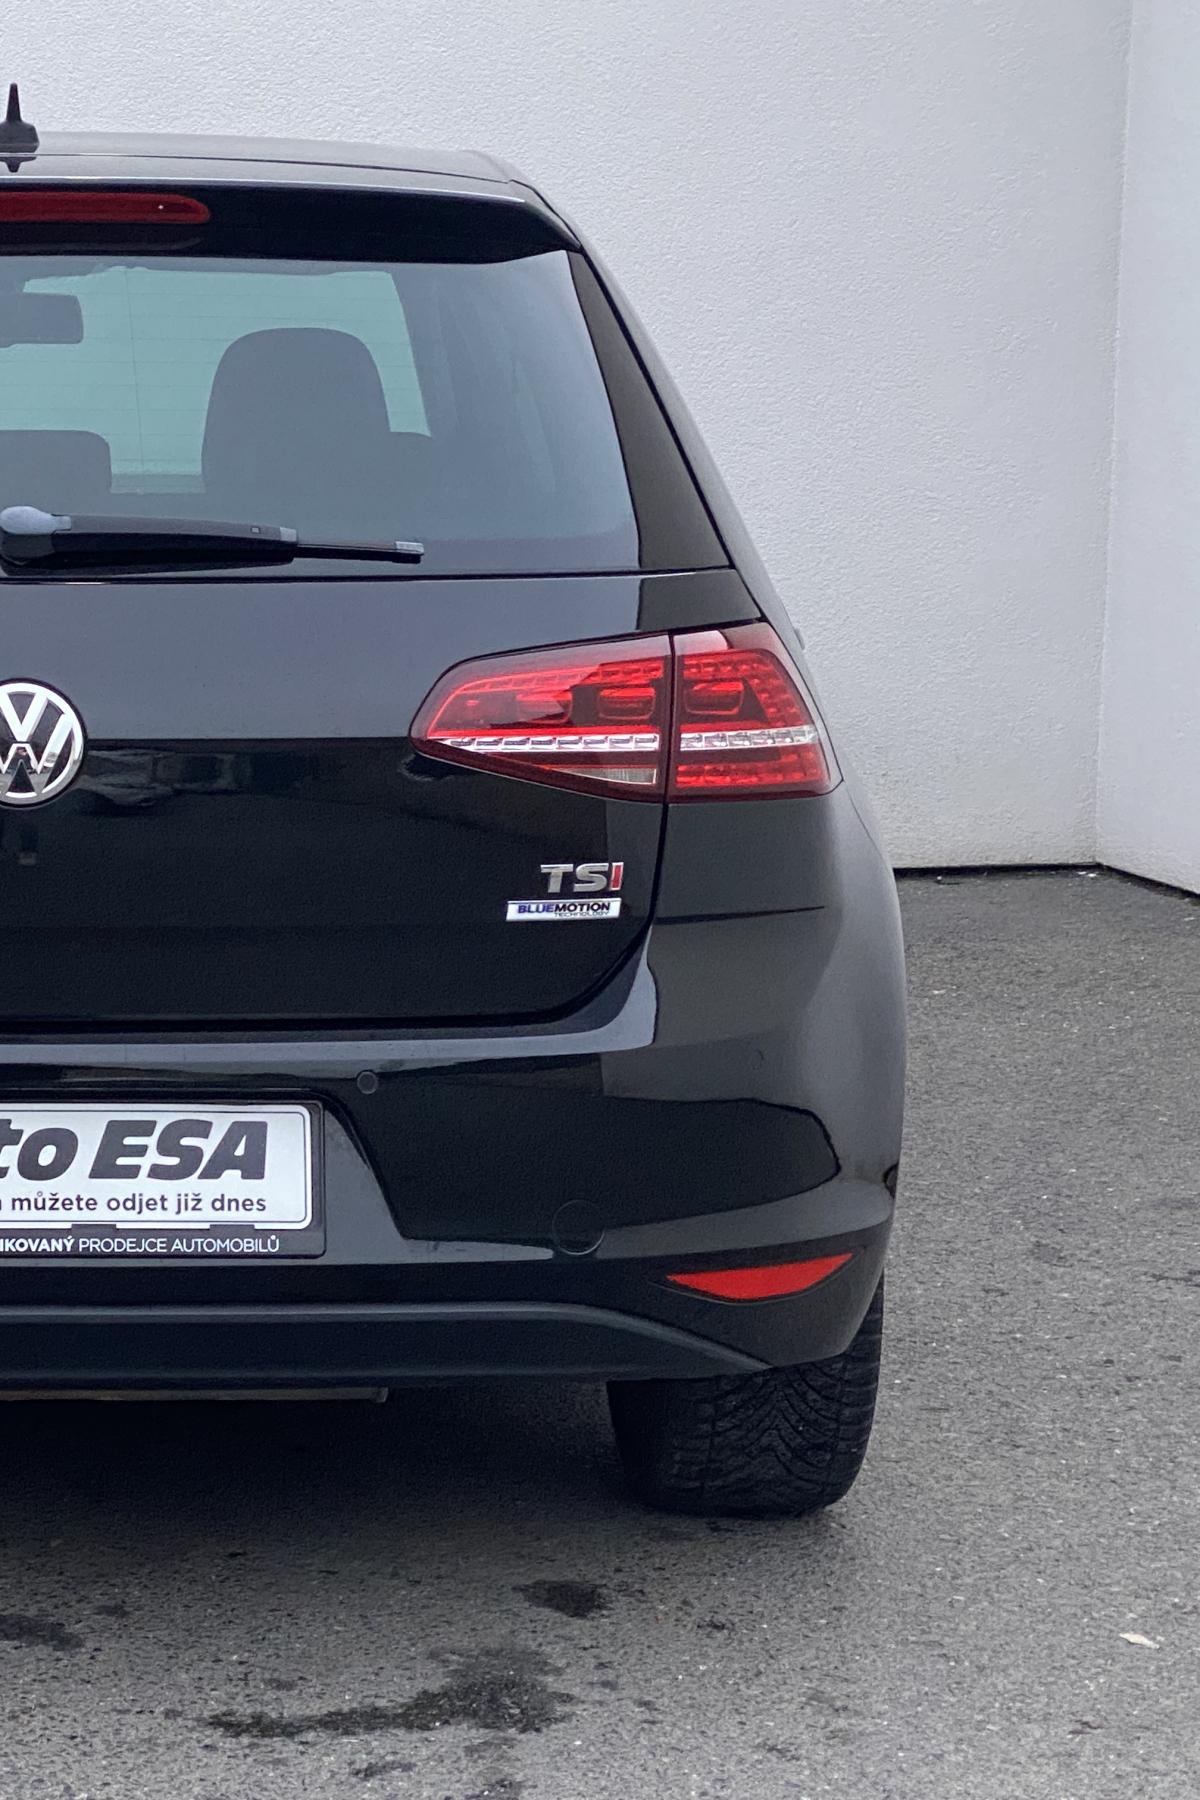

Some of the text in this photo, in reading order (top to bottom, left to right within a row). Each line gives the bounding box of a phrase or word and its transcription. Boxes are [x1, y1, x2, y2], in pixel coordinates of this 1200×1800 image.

[540, 862, 624, 893] TSI
[517, 902, 611, 914] BLUEMOTION
[88, 1118, 268, 1181] ESA
[11, 1190, 98, 1211] můžete
[106, 1193, 168, 1215] odjet
[175, 1193, 202, 1215] již
[211, 1194, 267, 1212] dnes
[78, 1238, 168, 1252] PRODEJCE
[170, 1234, 280, 1252] AUTOMOBILŮ
